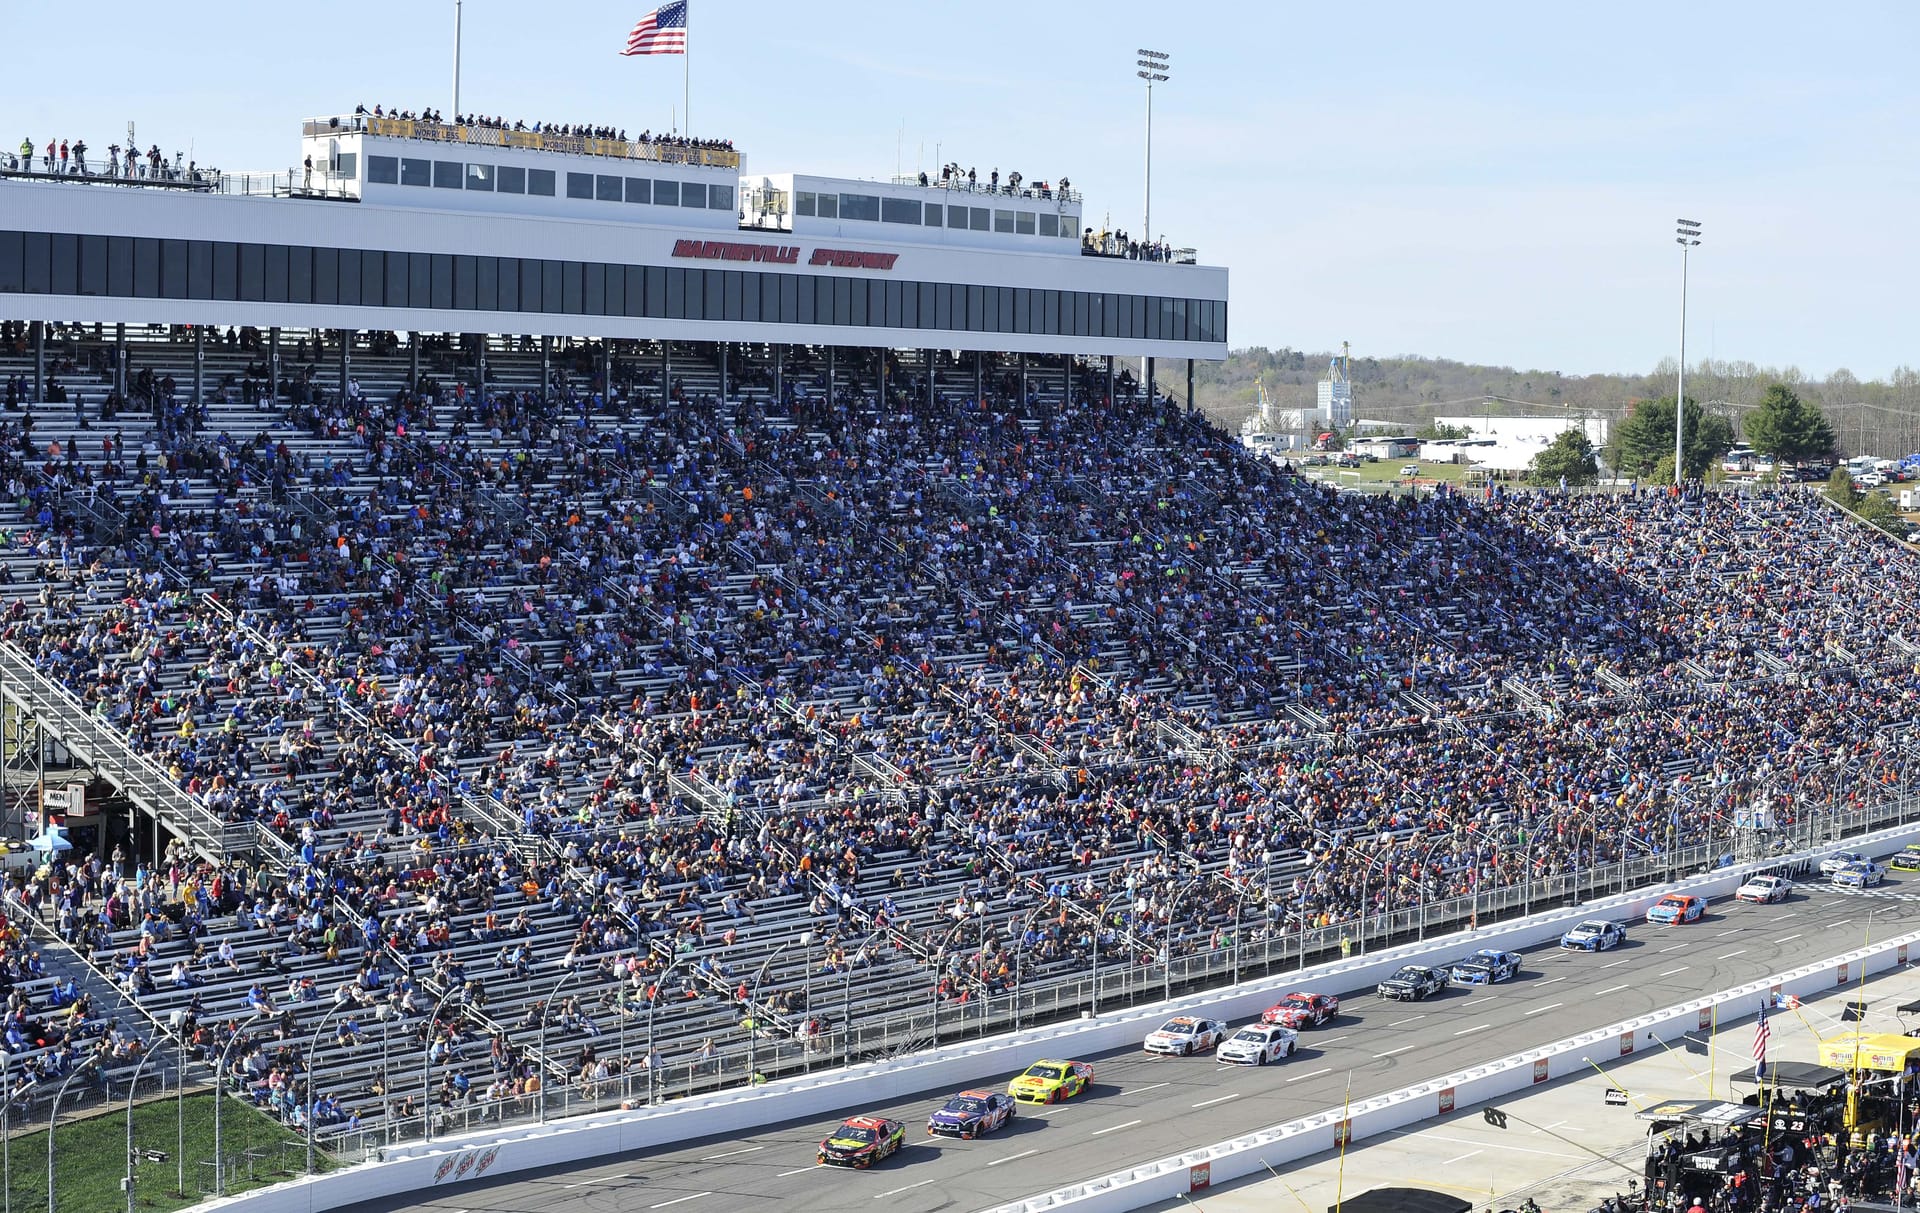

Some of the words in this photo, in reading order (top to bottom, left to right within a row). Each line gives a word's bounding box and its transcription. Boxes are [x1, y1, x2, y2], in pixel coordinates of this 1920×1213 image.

[414, 127, 441, 140] WORRY
[442, 129, 460, 140] LESS
[543, 141, 568, 151] WORRY
[672, 239, 800, 264] MARTINSVILLE
[809, 248, 900, 270] SPEEDWAY
[49, 793, 65, 801] MEN
[1273, 1042, 1281, 1056] 6
[1790, 1120, 1804, 1131] 23
